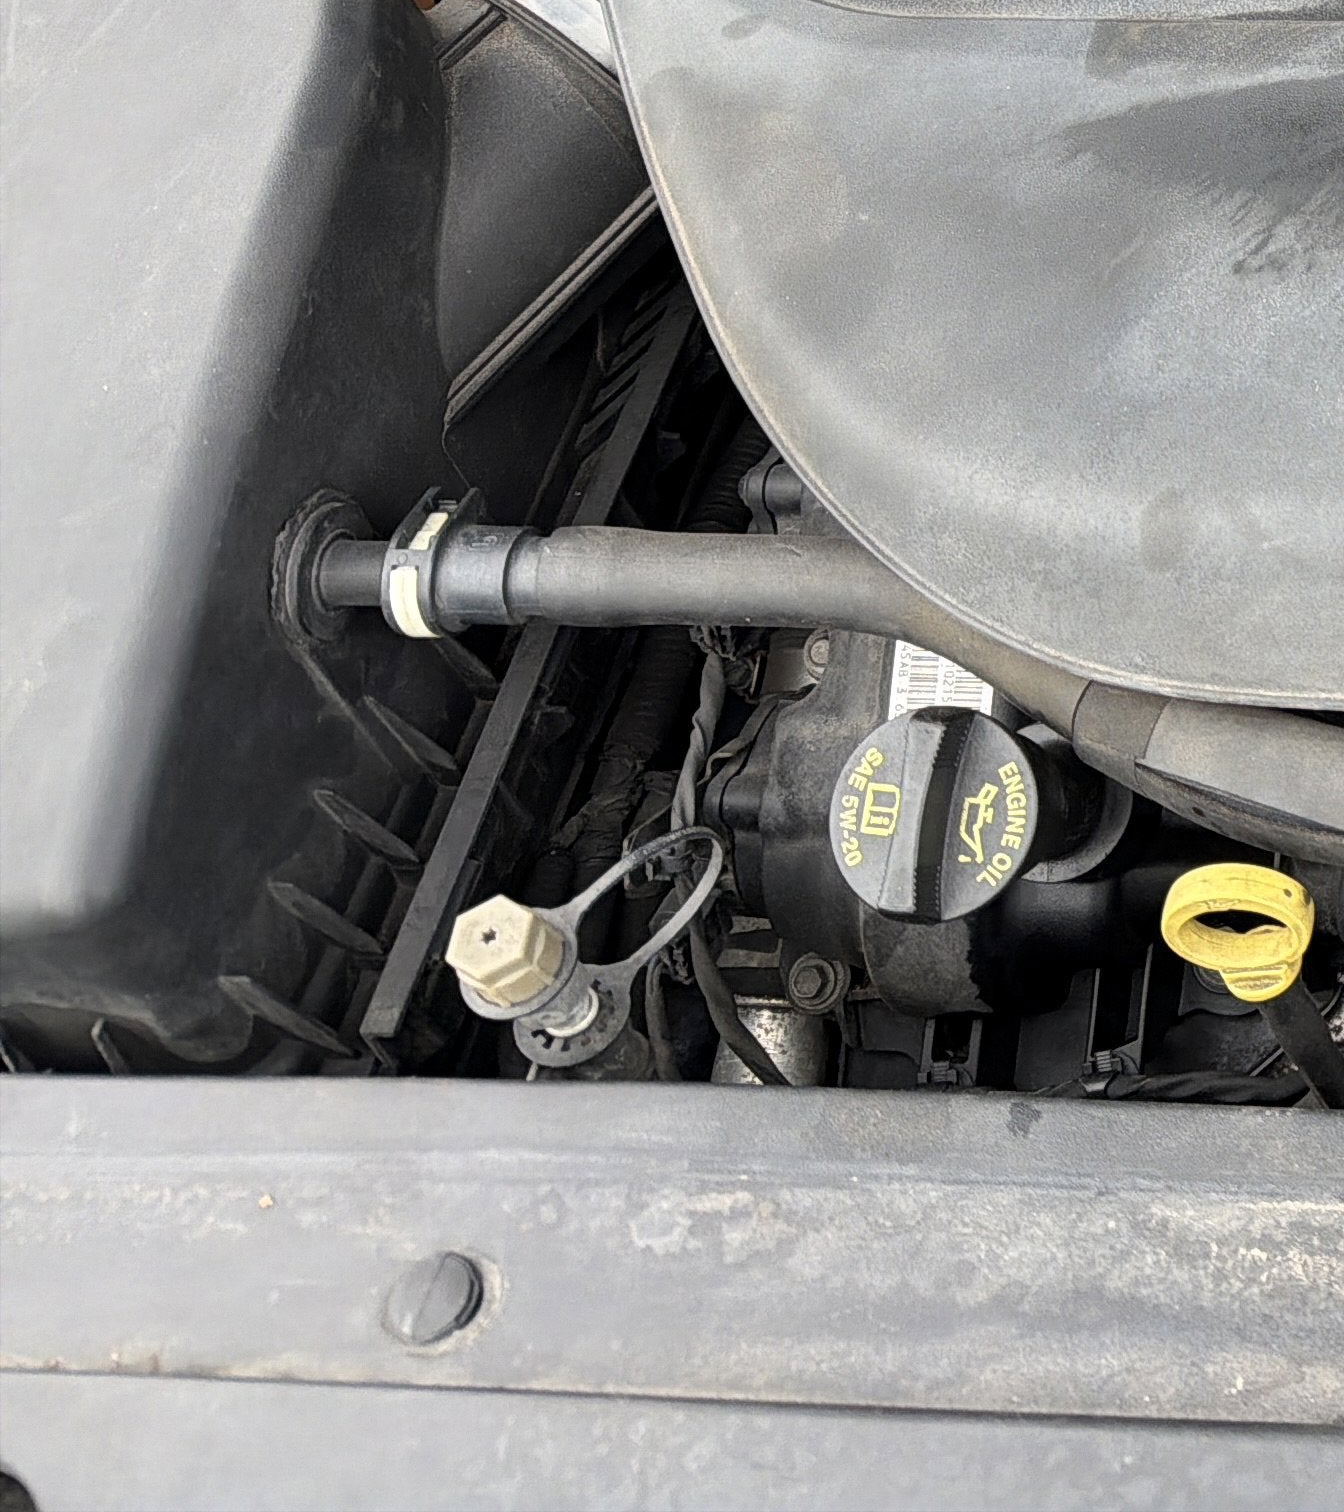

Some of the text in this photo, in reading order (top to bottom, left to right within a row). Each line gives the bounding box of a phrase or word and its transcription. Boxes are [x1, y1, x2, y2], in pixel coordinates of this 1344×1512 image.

[839, 746, 885, 867] SAE 5W-20
[975, 760, 1027, 887] ENGINE OIL
